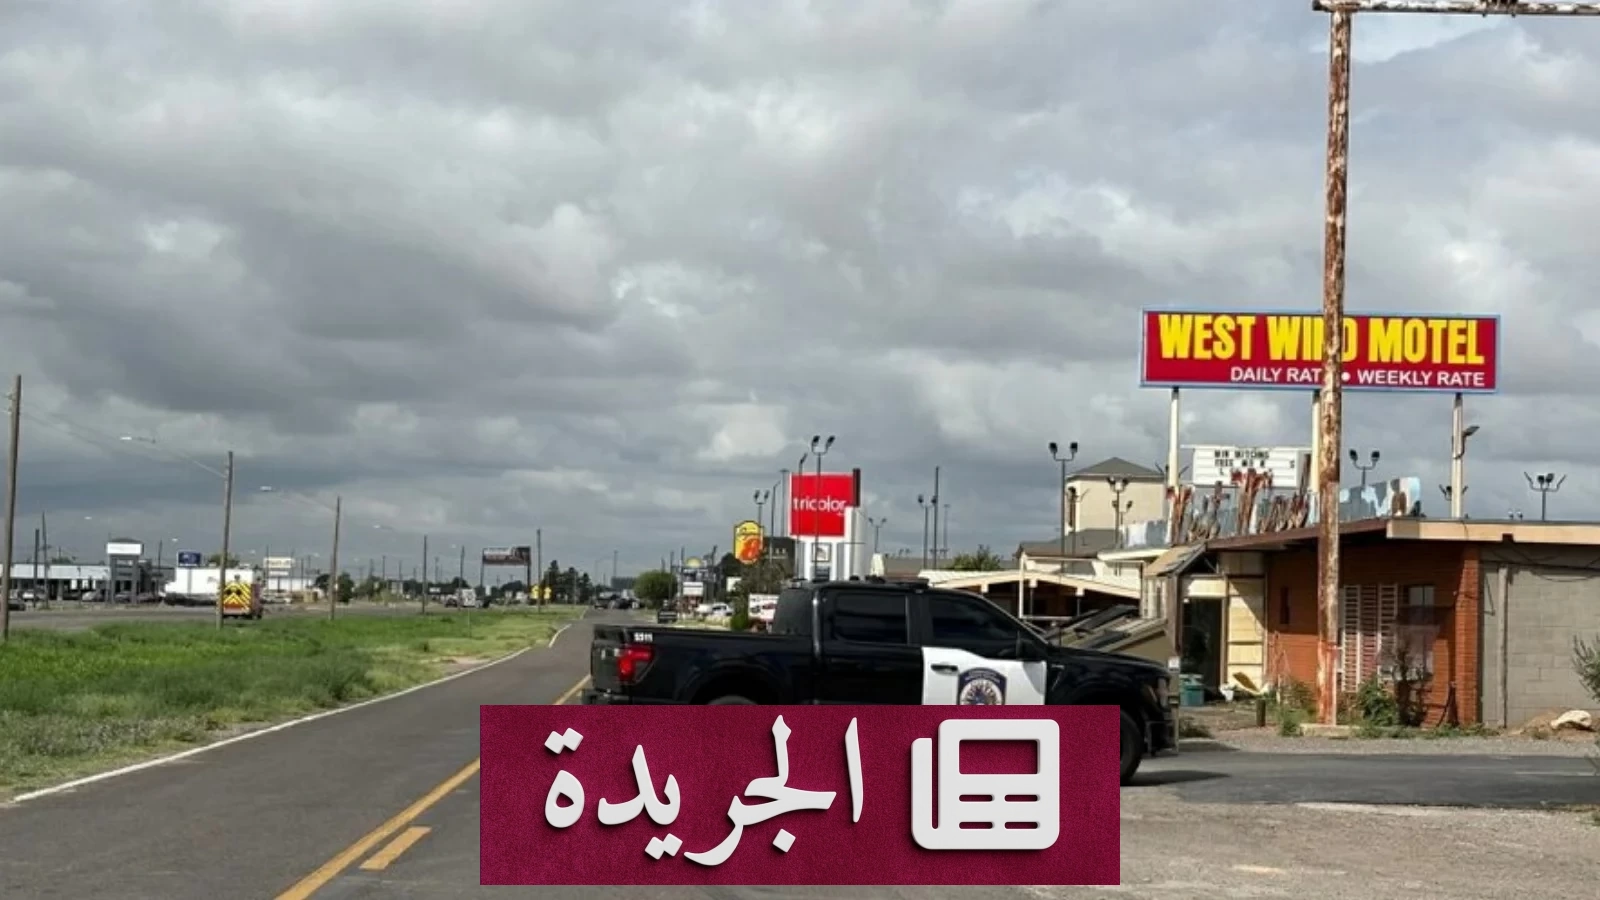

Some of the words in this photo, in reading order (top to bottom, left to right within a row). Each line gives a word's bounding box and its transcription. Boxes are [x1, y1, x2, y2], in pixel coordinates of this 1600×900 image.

[1158, 315, 1257, 360] WEST
[1369, 319, 1485, 364] MOTEL
[1231, 367, 1281, 383] DAILY
[1286, 369, 1323, 384] RAT
[1357, 370, 1433, 386] WEEKLY
[1438, 371, 1485, 386] RATE
[793, 495, 846, 512] tricolor
